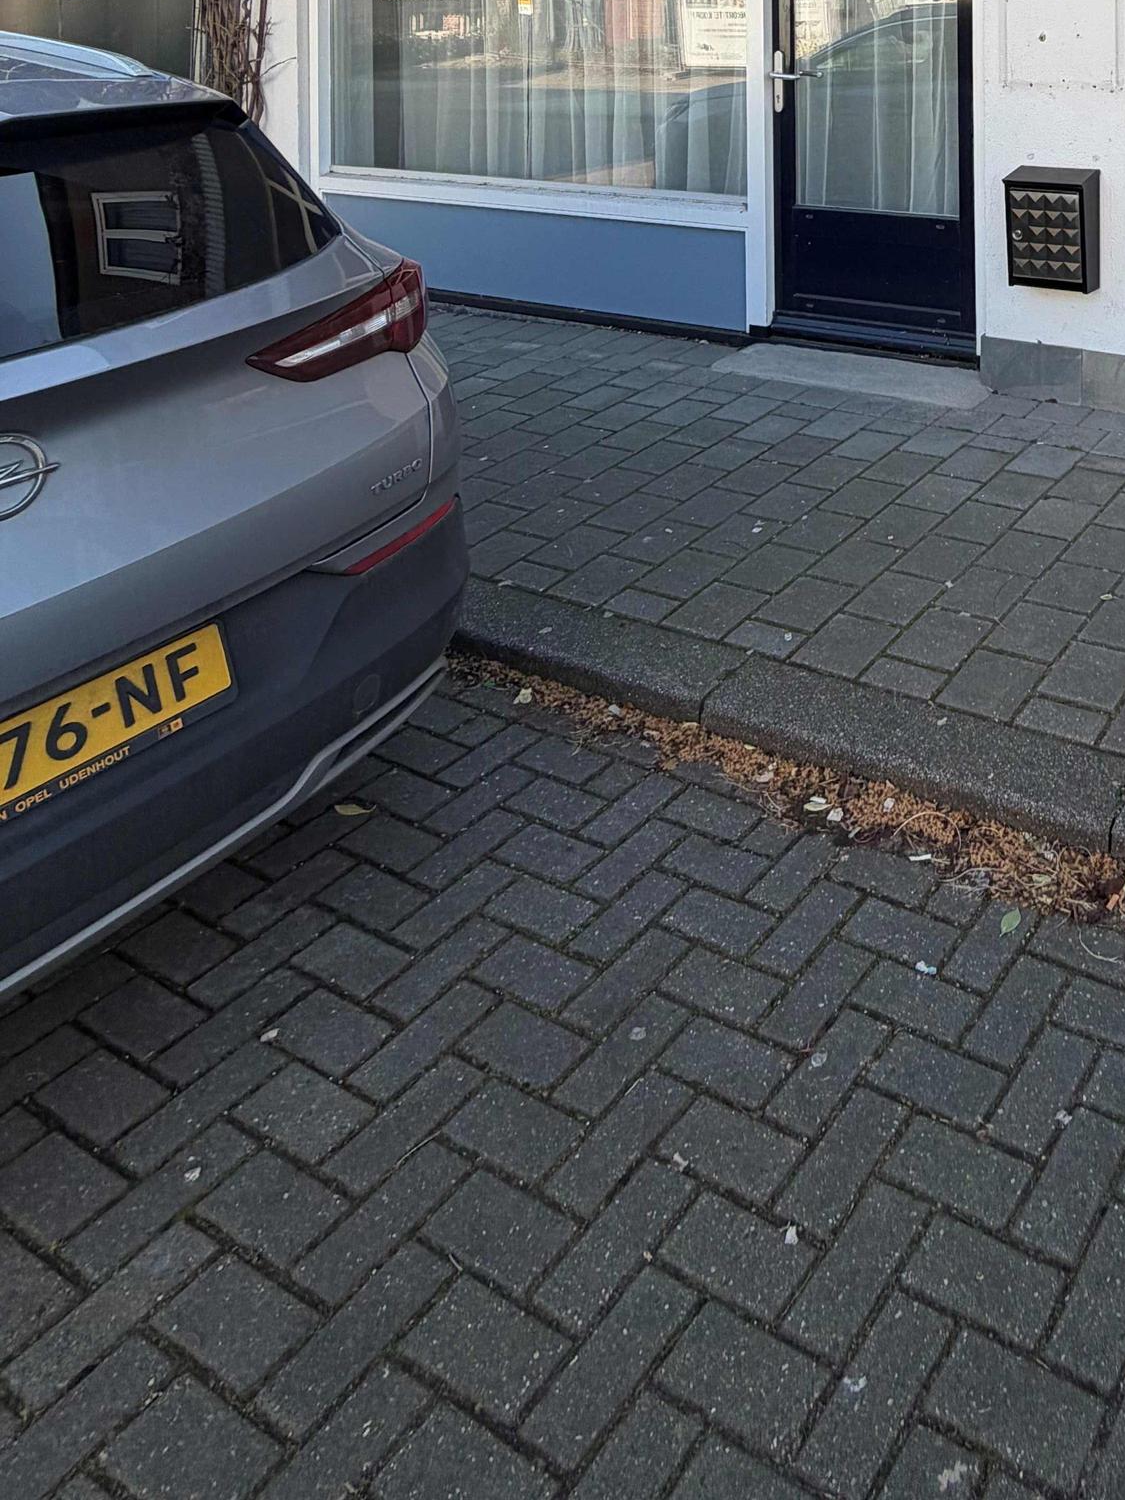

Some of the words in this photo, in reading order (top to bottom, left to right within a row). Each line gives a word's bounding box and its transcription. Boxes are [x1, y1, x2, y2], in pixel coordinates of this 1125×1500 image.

[370, 458, 422, 494] TURBO
[0, 642, 199, 791] 76-NF
[15, 788, 53, 813] OPEL
[59, 745, 130, 790] UDENHOUT
